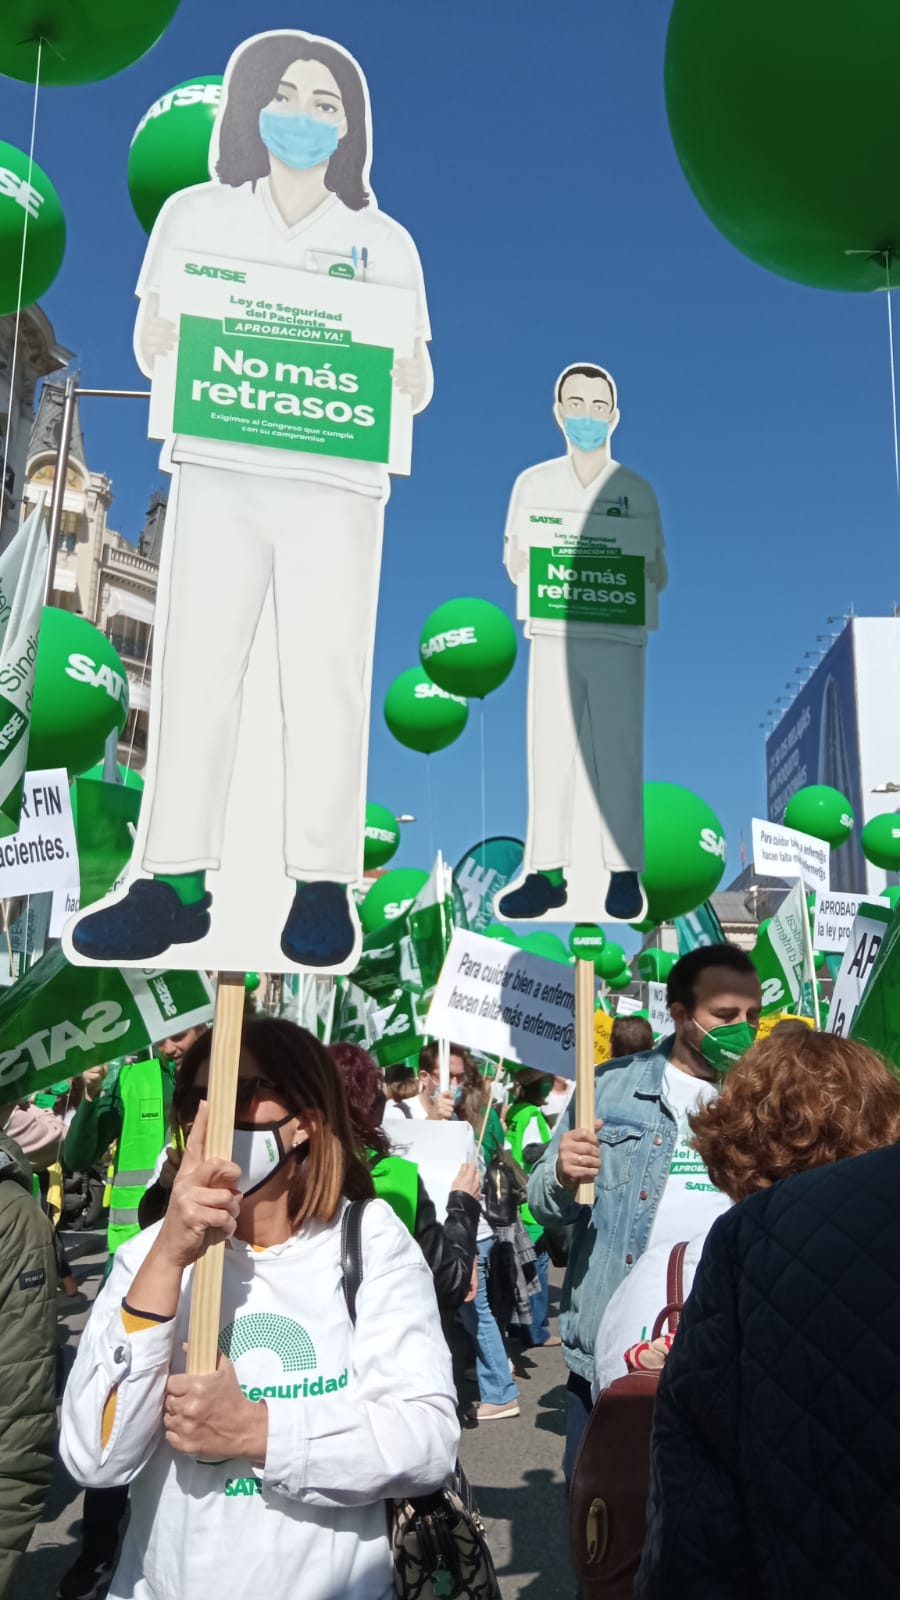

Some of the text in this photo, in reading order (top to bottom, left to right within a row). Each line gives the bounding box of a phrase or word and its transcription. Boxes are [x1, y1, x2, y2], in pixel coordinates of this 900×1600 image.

[183, 263, 247, 283] SATSE
[230, 295, 343, 321] Ley de Seguridad
[246, 309, 326, 327] del Paciente
[235, 322, 345, 342] APROBACIÓN YA!
[213, 346, 359, 394] No más
[191, 379, 376, 427] retrasos
[211, 412, 250, 424] Exigimos
[261, 420, 303, 432] Congreso
[304, 427, 321, 435] que
[322, 430, 355, 440] cumpla
[260, 428, 271, 436] su
[271, 430, 326, 443] compromiso
[530, 515, 563, 525] SATSE
[547, 563, 628, 586] No más
[538, 583, 637, 605] retrasos
[421, 626, 478, 660] SATSE
[33, 785, 62, 817] FIN
[819, 900, 856, 917] APROBAD
[818, 921, 824, 937] la
[826, 922, 837, 941] ley
[458, 952, 481, 979] Para
[482, 962, 513, 989] cuidar
[512, 968, 535, 998] bien
[533, 981, 542, 998] a
[448, 985, 478, 1014] hacen
[478, 994, 502, 1021] falta
[501, 1003, 524, 1029] más
